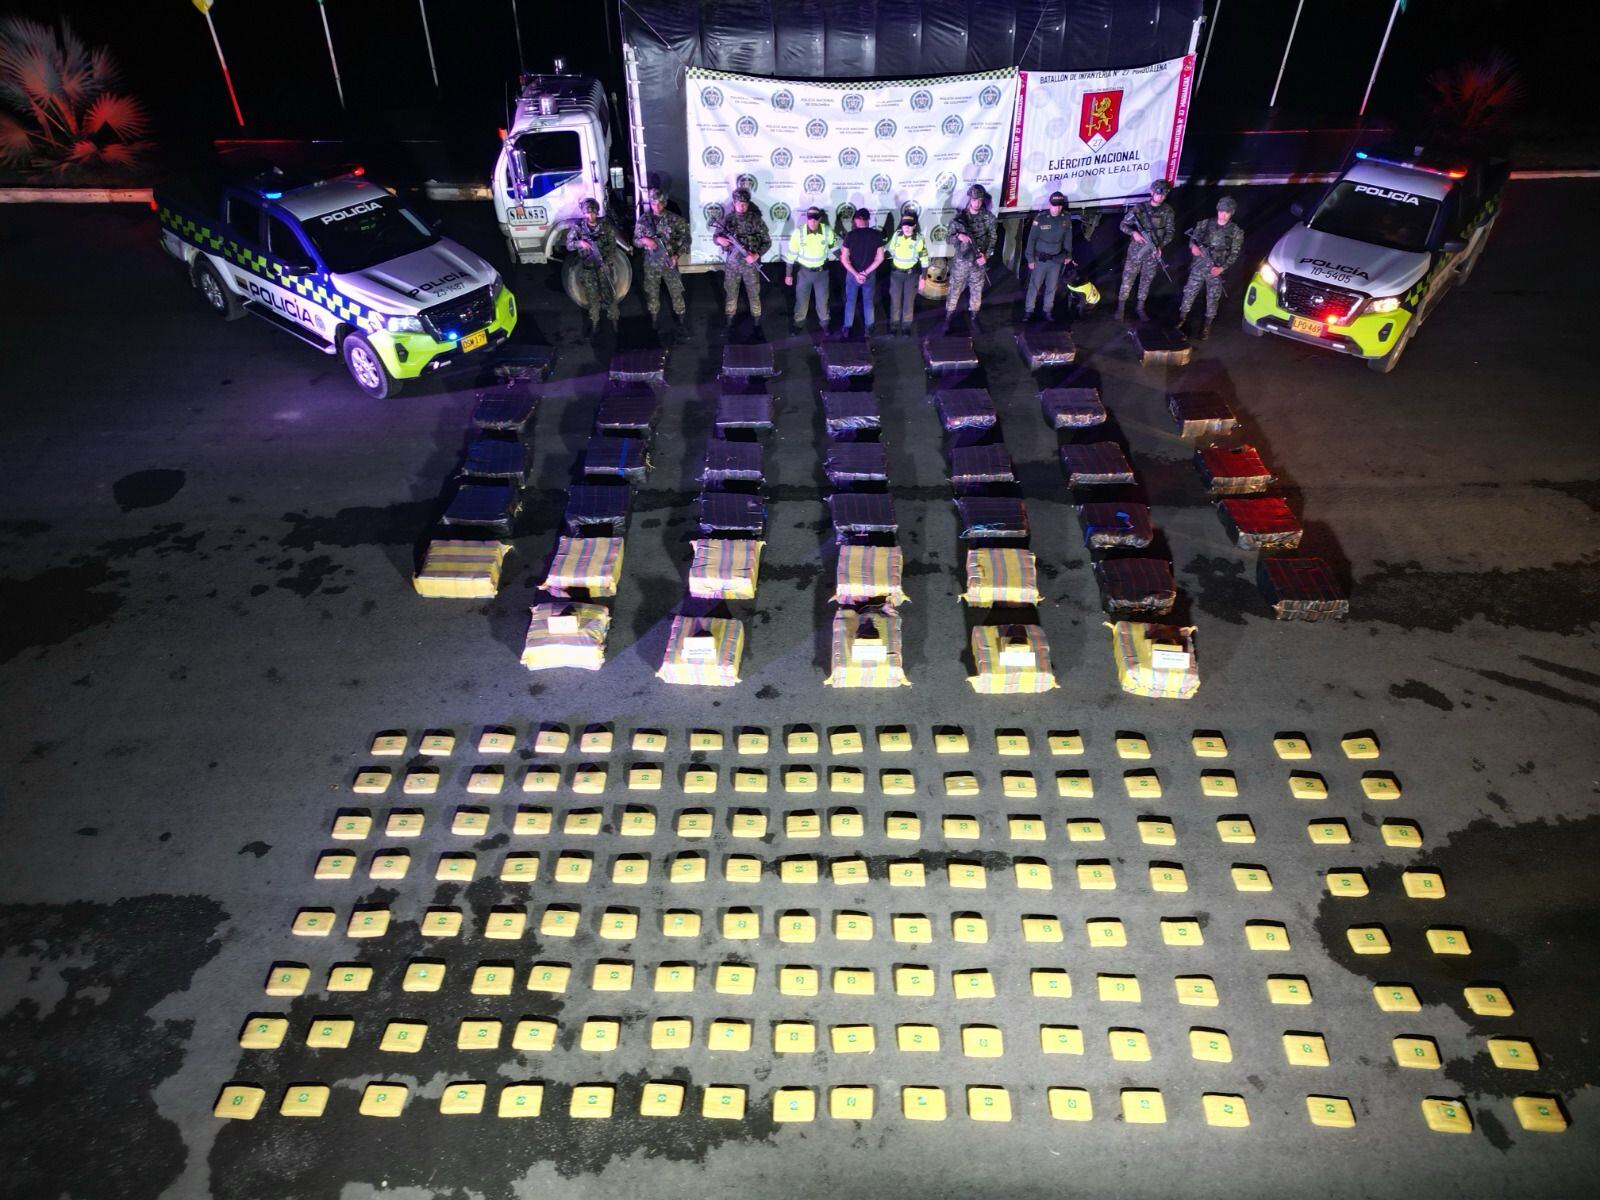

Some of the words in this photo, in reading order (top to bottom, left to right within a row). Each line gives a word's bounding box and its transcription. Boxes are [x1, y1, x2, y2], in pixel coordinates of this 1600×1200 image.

[1070, 73, 1078, 81] DE
[1092, 138, 1103, 147] 27
[1048, 156, 1092, 170] EJÉRCITO
[1094, 150, 1140, 165] NACIONAL
[1036, 172, 1069, 183] PATRIA
[1071, 167, 1106, 179] HONOR
[1108, 162, 1150, 175] LEALTAD
[1354, 184, 1419, 206] POLICÍA
[320, 202, 383, 225] POLICÍA
[1299, 257, 1369, 281] POLICÍA
[1310, 266, 1353, 284] 10-5405
[249, 281, 315, 327] POLICÍA
